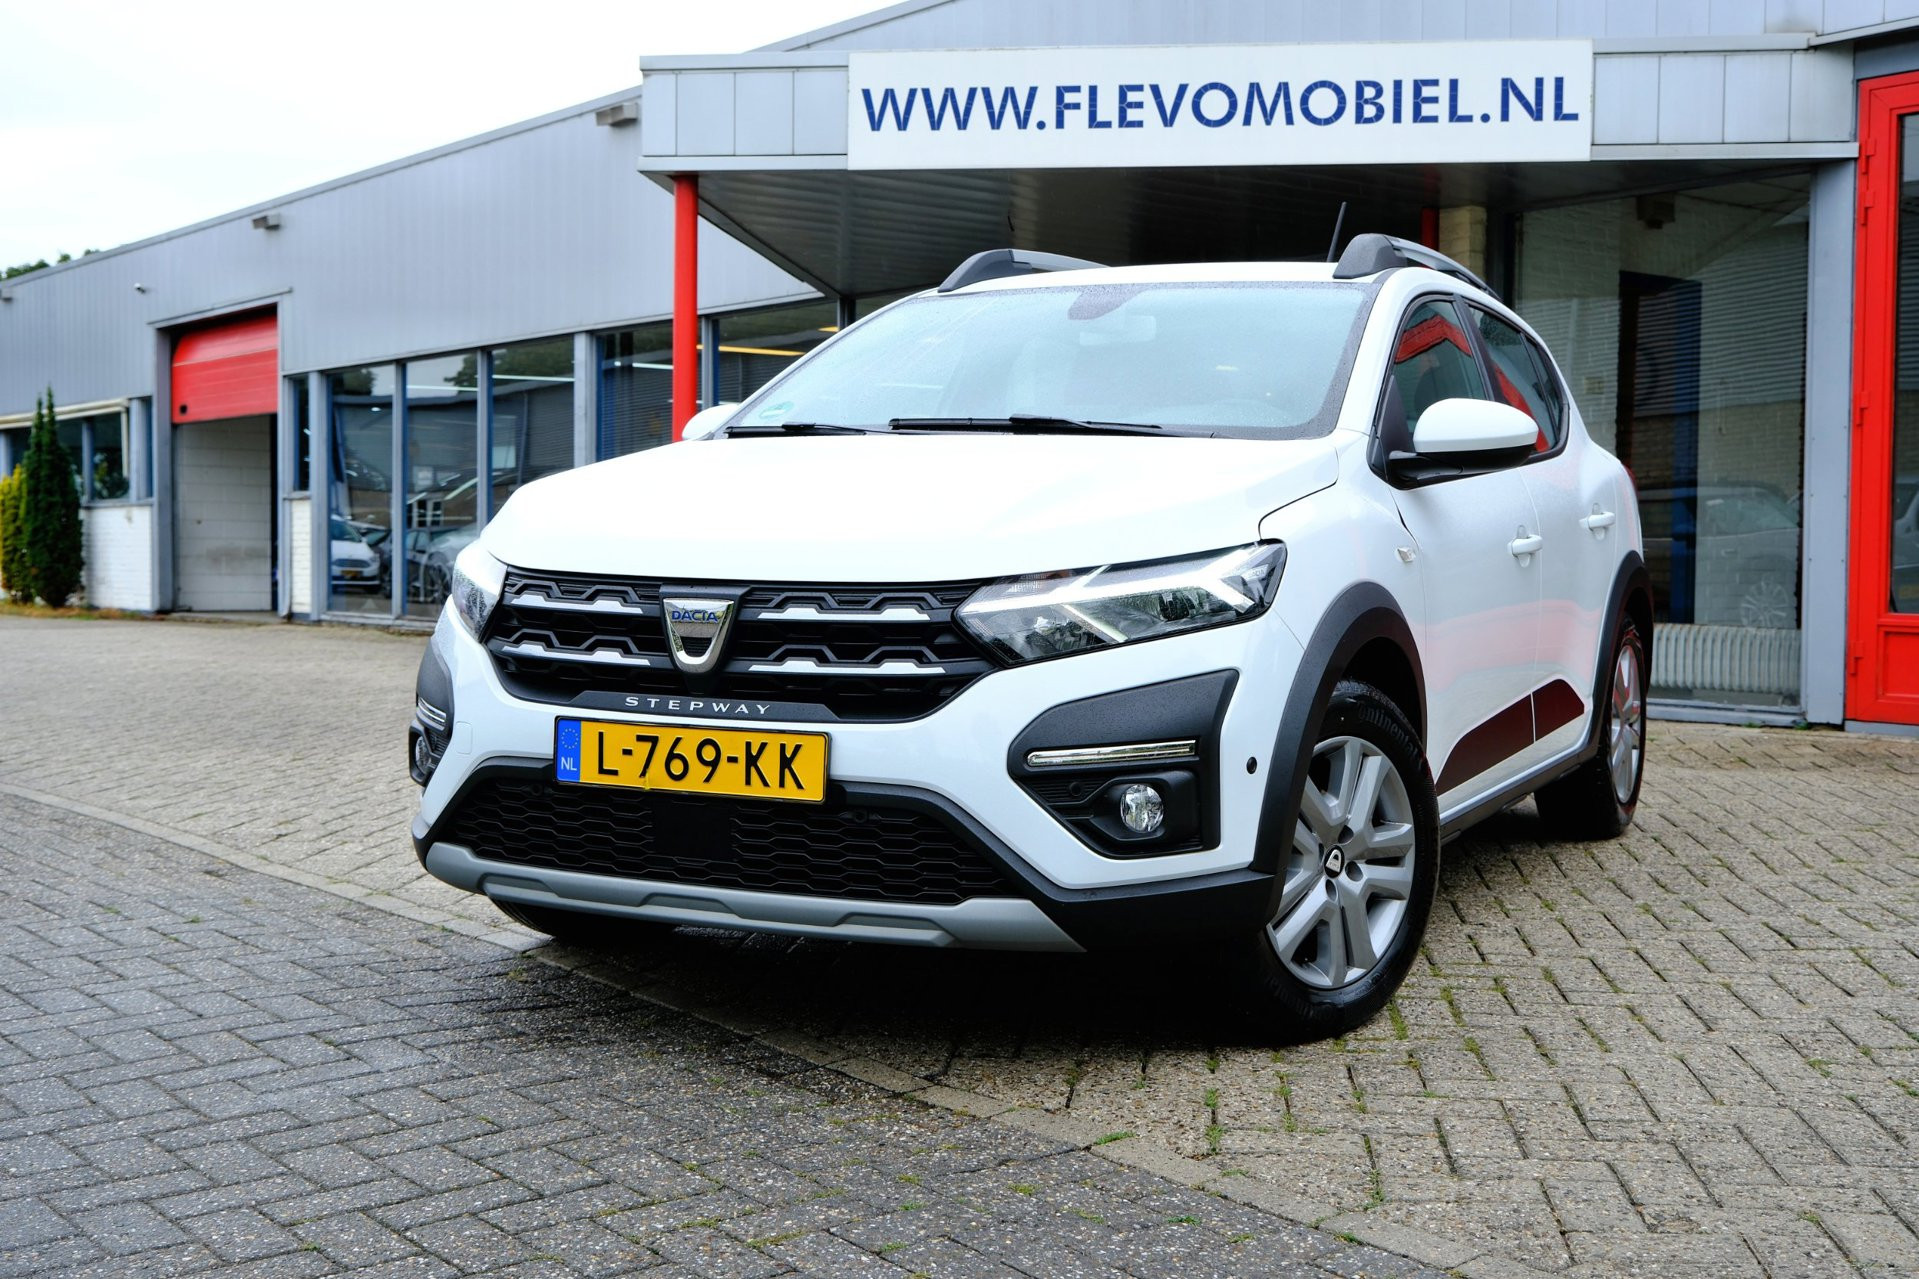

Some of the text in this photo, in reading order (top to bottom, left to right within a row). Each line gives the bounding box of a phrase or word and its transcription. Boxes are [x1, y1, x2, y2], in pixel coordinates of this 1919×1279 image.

[861, 76, 1580, 132] WWW.FLEVOMOBIEL.NL
[671, 609, 718, 622] DACIA
[624, 696, 770, 715] STEPWAY
[561, 731, 805, 790] NL L-769-KK
